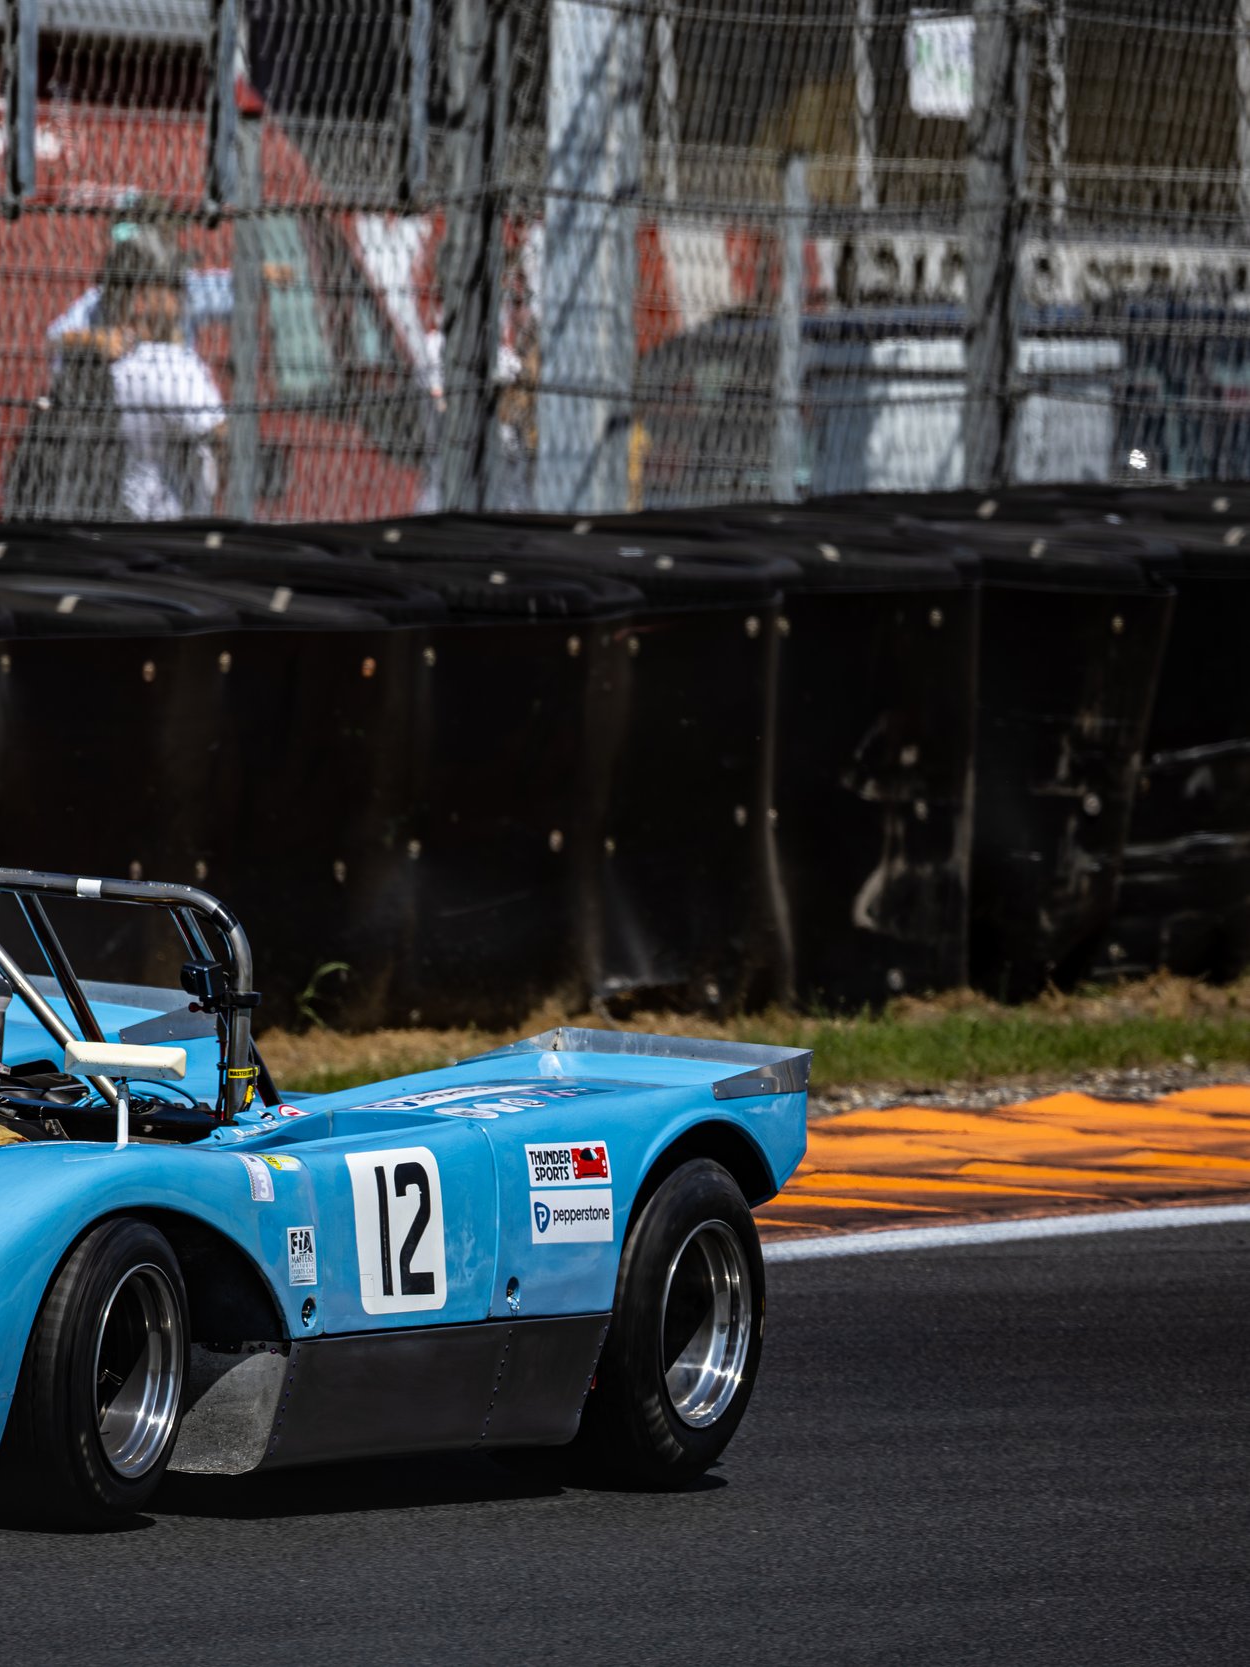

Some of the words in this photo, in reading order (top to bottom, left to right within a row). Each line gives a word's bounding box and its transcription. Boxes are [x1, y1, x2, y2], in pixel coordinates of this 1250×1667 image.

[528, 1149, 571, 1166] THUNDER
[534, 1166, 570, 1182] SPORTS
[552, 1205, 610, 1226] pepperstone
[374, 1161, 435, 1297] 12
